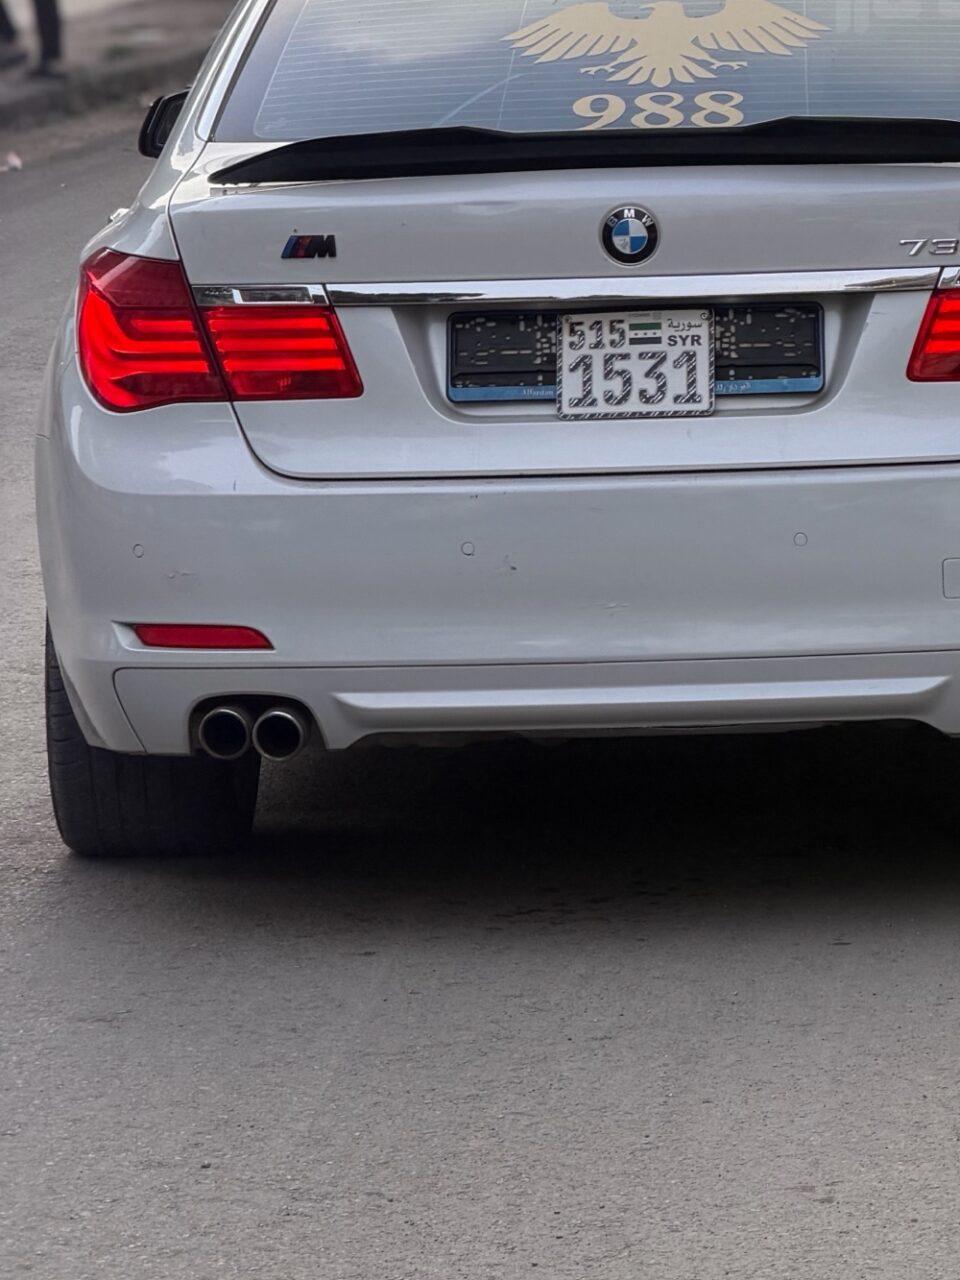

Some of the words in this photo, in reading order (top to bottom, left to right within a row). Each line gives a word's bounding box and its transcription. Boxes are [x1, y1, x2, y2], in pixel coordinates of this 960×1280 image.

[572, 90, 744, 130] 988
[606, 208, 655, 228] BMW
[568, 319, 626, 350] 515
[667, 319, 702, 332] سورية
[667, 334, 702, 347] SYR
[568, 350, 702, 408] 1531
